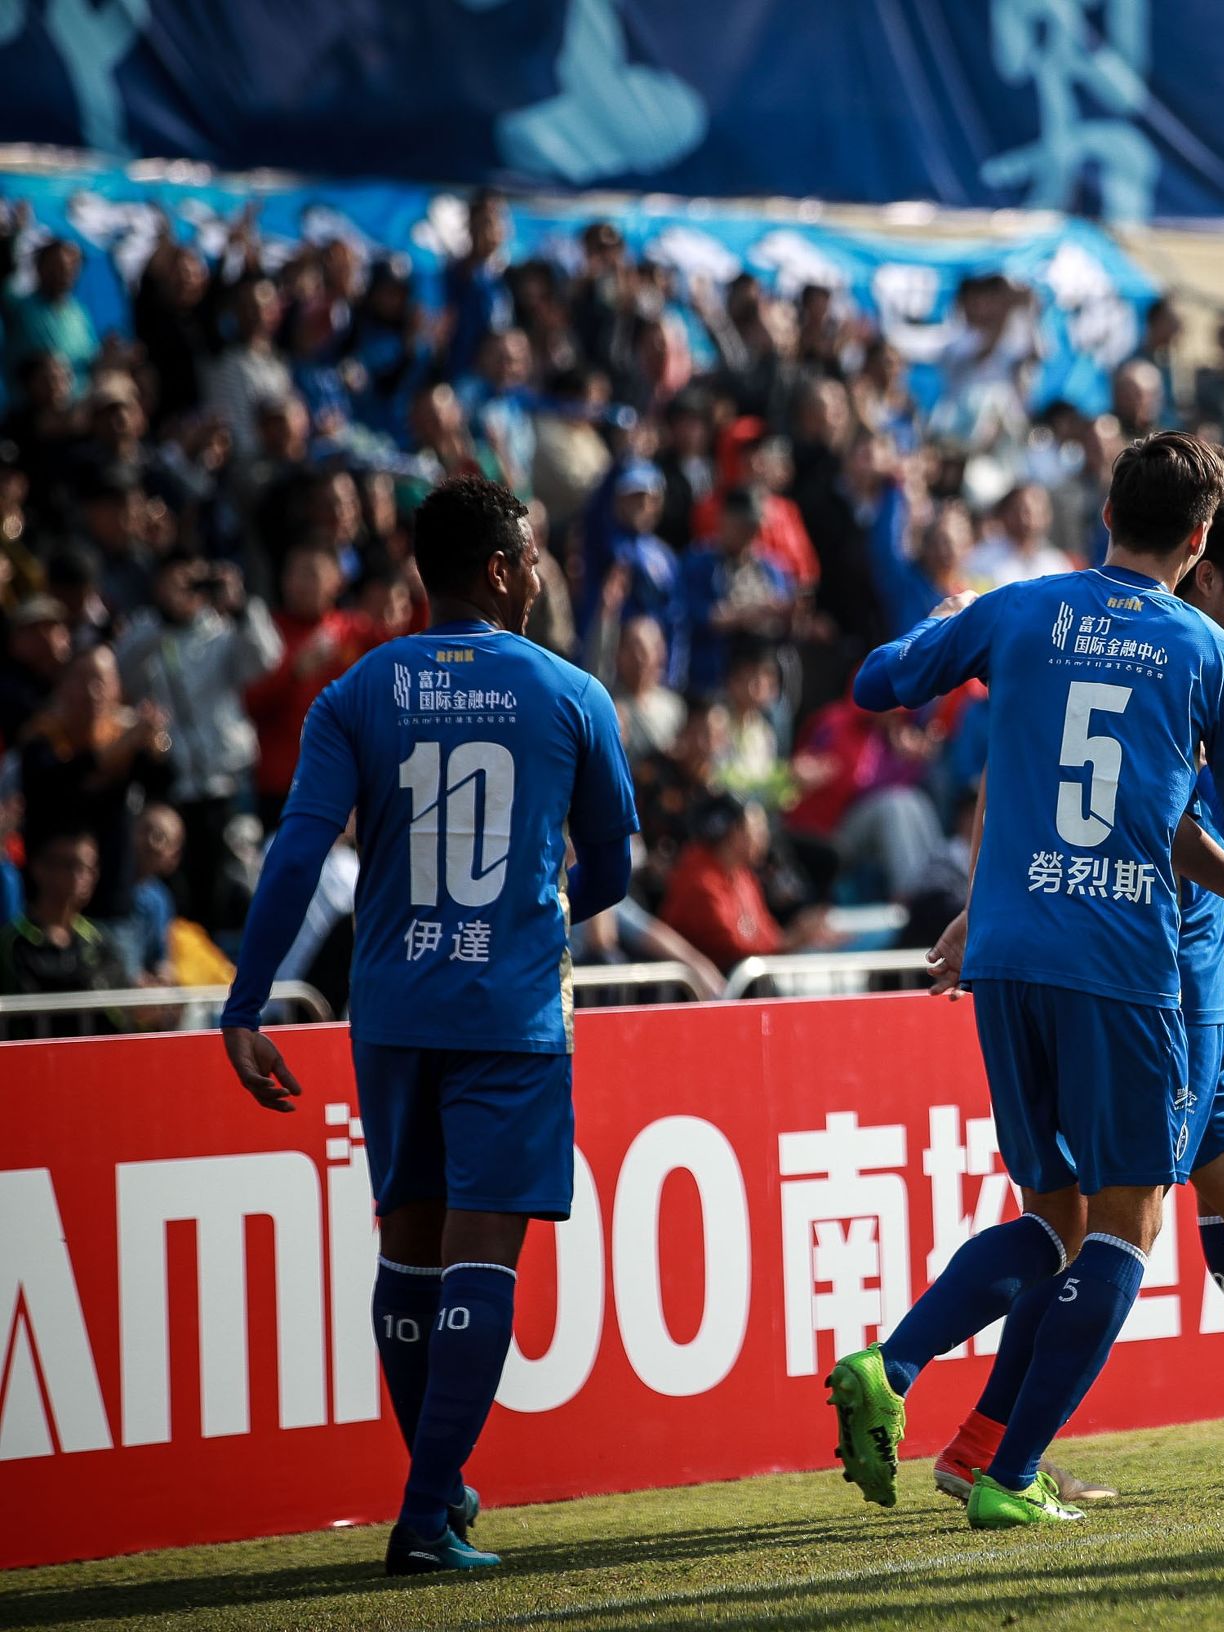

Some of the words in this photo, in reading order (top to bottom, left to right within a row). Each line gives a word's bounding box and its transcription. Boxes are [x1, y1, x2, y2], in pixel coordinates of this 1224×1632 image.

[1078, 615, 1112, 635] 富力
[1074, 634, 1168, 665] 国际金融中心
[418, 669, 450, 689] 富力
[419, 689, 517, 710] 国际金融中心
[1056, 680, 1133, 847] 5
[399, 741, 515, 908] 10
[1028, 850, 1156, 904] 勞烈斯
[404, 918, 492, 963] 伊達
[1058, 1277, 1080, 1302] 5
[383, 1314, 420, 1342] 10
[437, 1306, 470, 1331] 10
